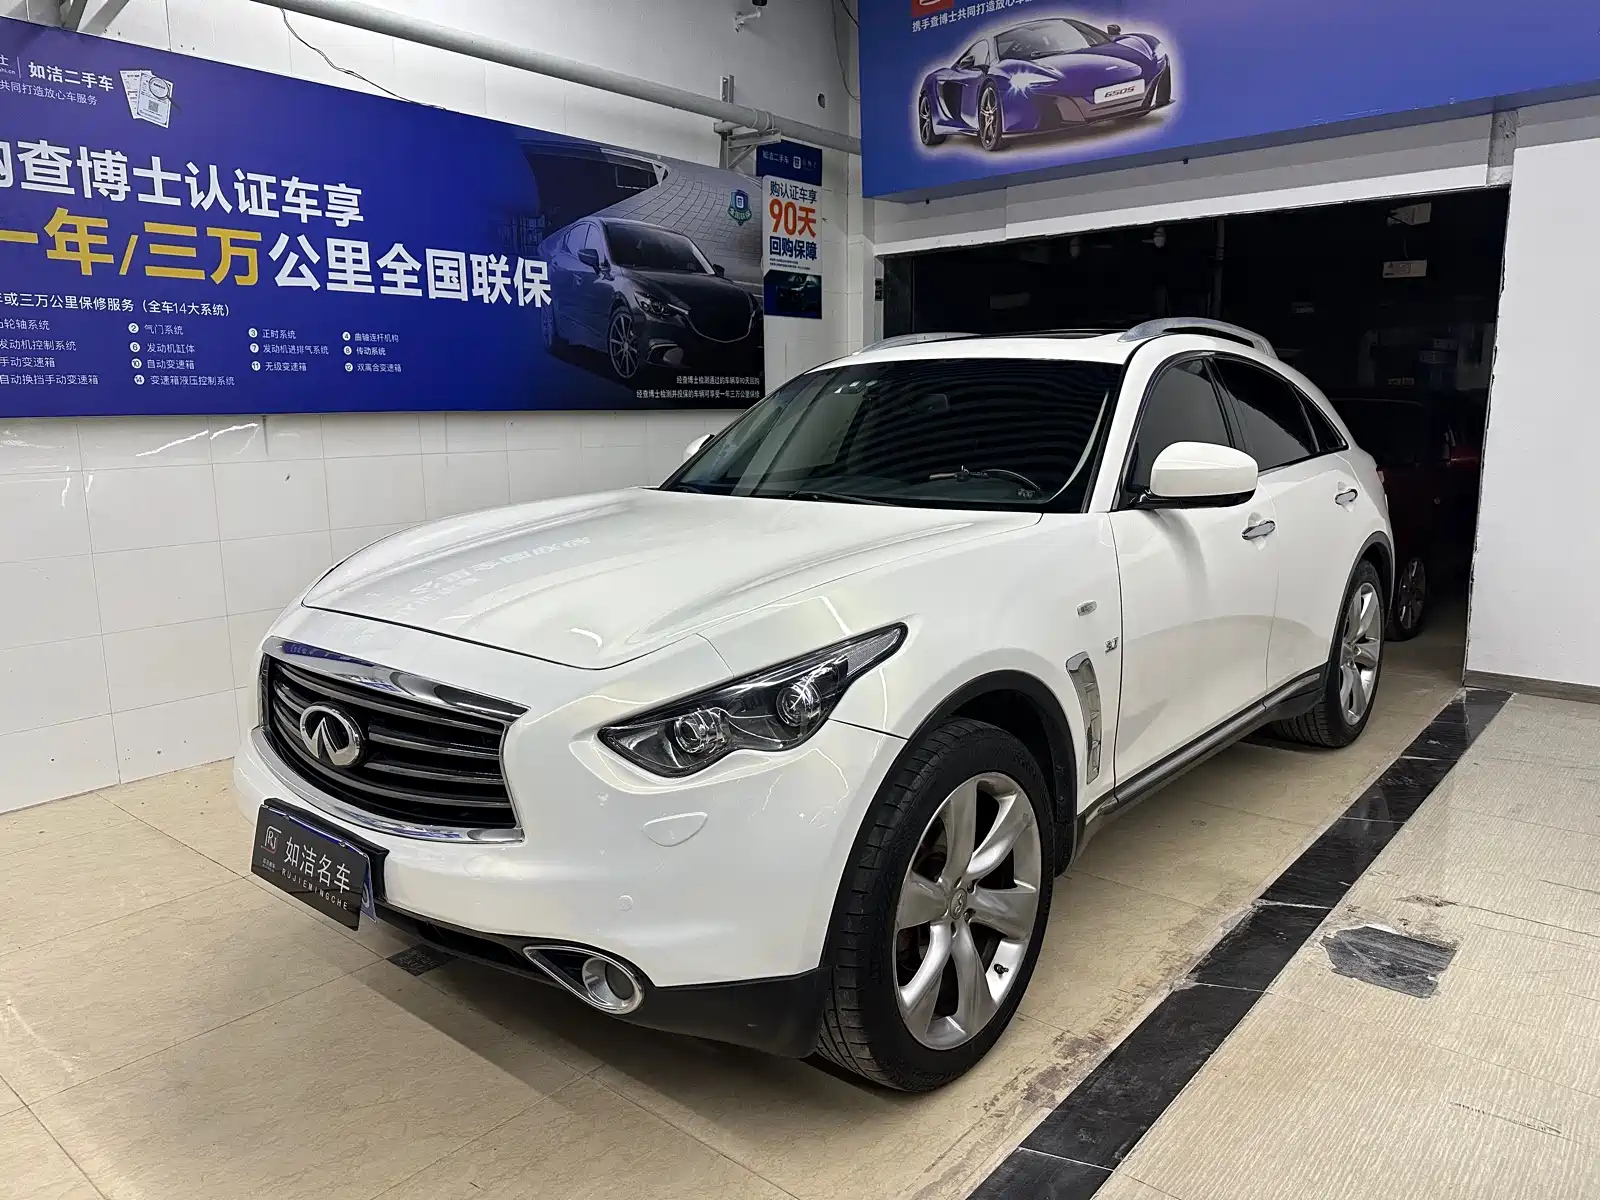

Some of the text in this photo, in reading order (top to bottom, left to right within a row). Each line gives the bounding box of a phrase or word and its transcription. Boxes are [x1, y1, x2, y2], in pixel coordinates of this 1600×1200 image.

[912, 0, 1032, 32] 携手查博士共同打造放心
[28, 61, 114, 92] 如洁二手车
[0, 140, 364, 227] 查博士认证车享
[769, 181, 817, 204] 购认证车享
[769, 198, 817, 238] 90天
[769, 235, 818, 261] 回购保障
[144, 323, 184, 336] 气门系统
[262, 328, 297, 340] 正时系统
[0, 356, 56, 368] 手动变速箱
[356, 346, 386, 357] 传动系统
[146, 359, 195, 370] 自动变速箱
[265, 361, 307, 372] 无级变速箱
[283, 836, 351, 894] 如洁名车
